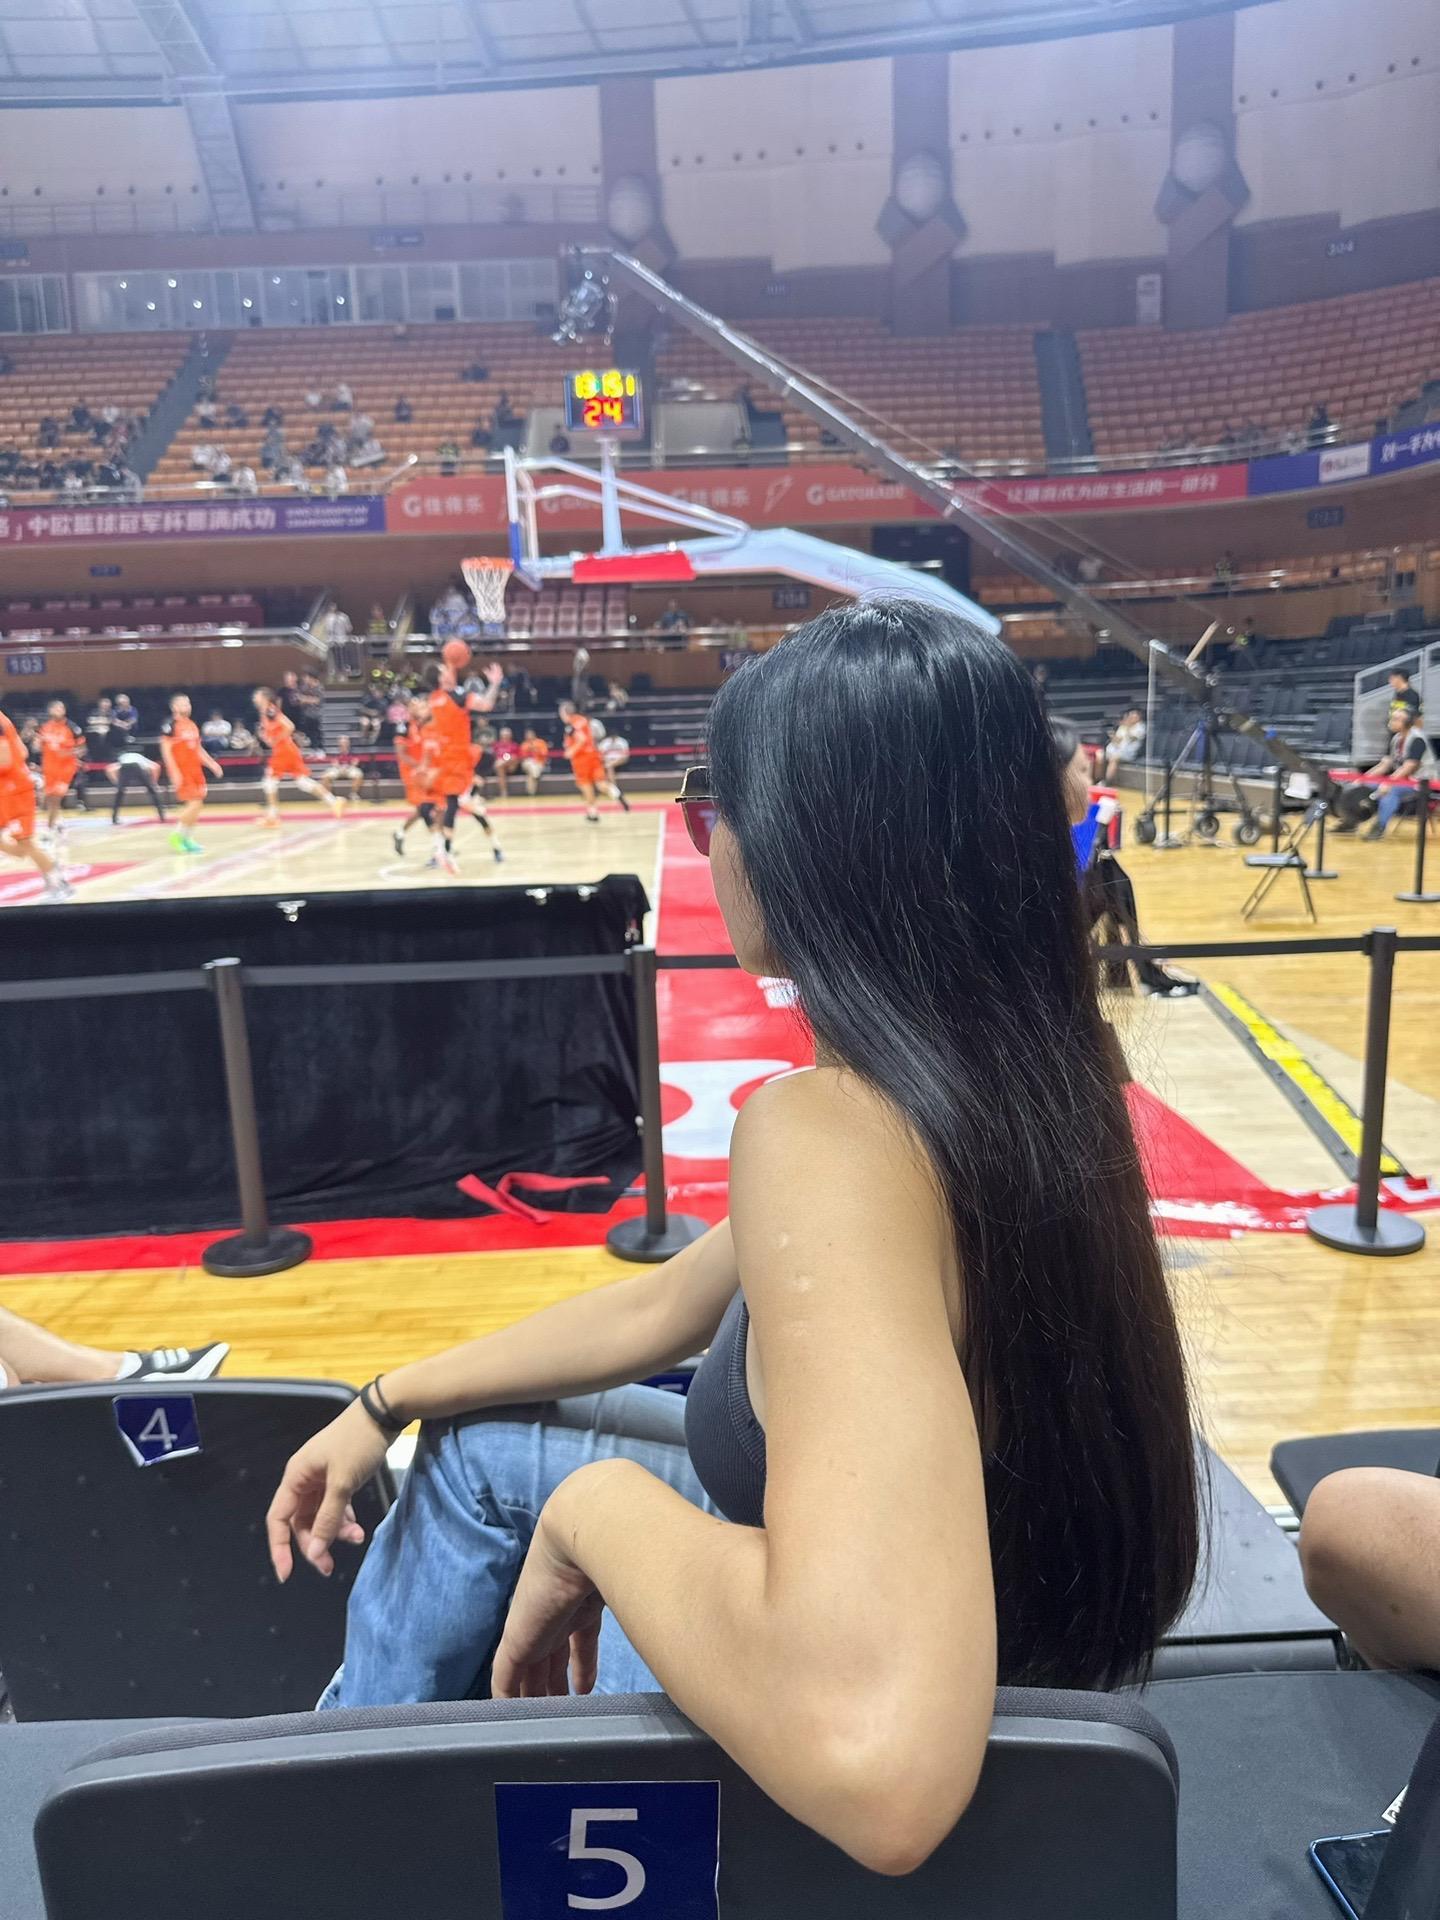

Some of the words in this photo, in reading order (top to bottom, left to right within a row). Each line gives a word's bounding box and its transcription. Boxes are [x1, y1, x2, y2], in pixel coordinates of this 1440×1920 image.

[583, 399, 622, 426] 24
[10, 655, 43, 675] 103
[138, 1407, 179, 1450] 4
[567, 1808, 646, 1910] 5
